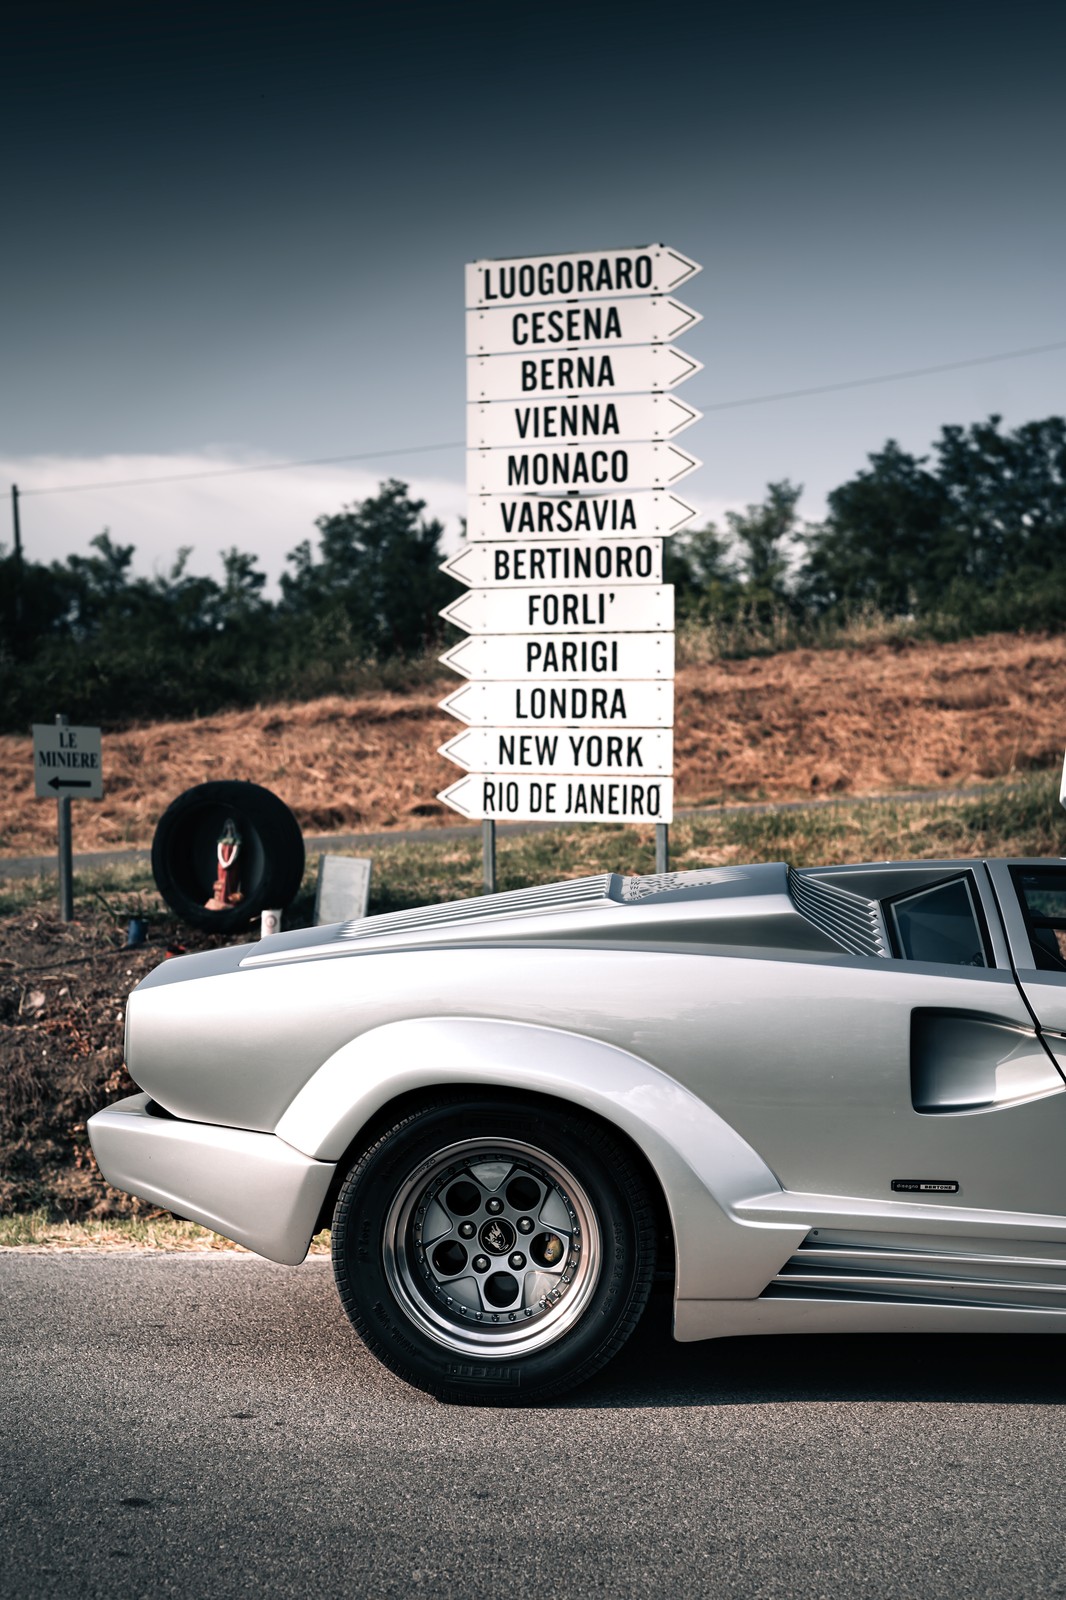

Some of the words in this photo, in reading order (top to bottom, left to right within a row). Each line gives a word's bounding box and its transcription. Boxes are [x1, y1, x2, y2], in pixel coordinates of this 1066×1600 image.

[485, 255, 652, 300] LUOGORARO
[513, 307, 621, 345] CESENA
[522, 356, 614, 391] BERNA
[515, 404, 619, 438] VIENNA
[509, 450, 627, 485] MONACO
[501, 499, 636, 532] VARSAVIA
[495, 546, 651, 580] BERTINORO
[529, 593, 614, 625] FORLI'
[527, 641, 617, 672] PARIGI
[517, 688, 626, 719] LONDRA
[60, 732, 77, 749] LE
[500, 736, 558, 765] NEW
[569, 736, 643, 767] YORK
[39, 751, 99, 769] MINIERE
[484, 782, 518, 812] RIO
[530, 783, 556, 813] DE
[565, 784, 660, 816] JANEIRO
